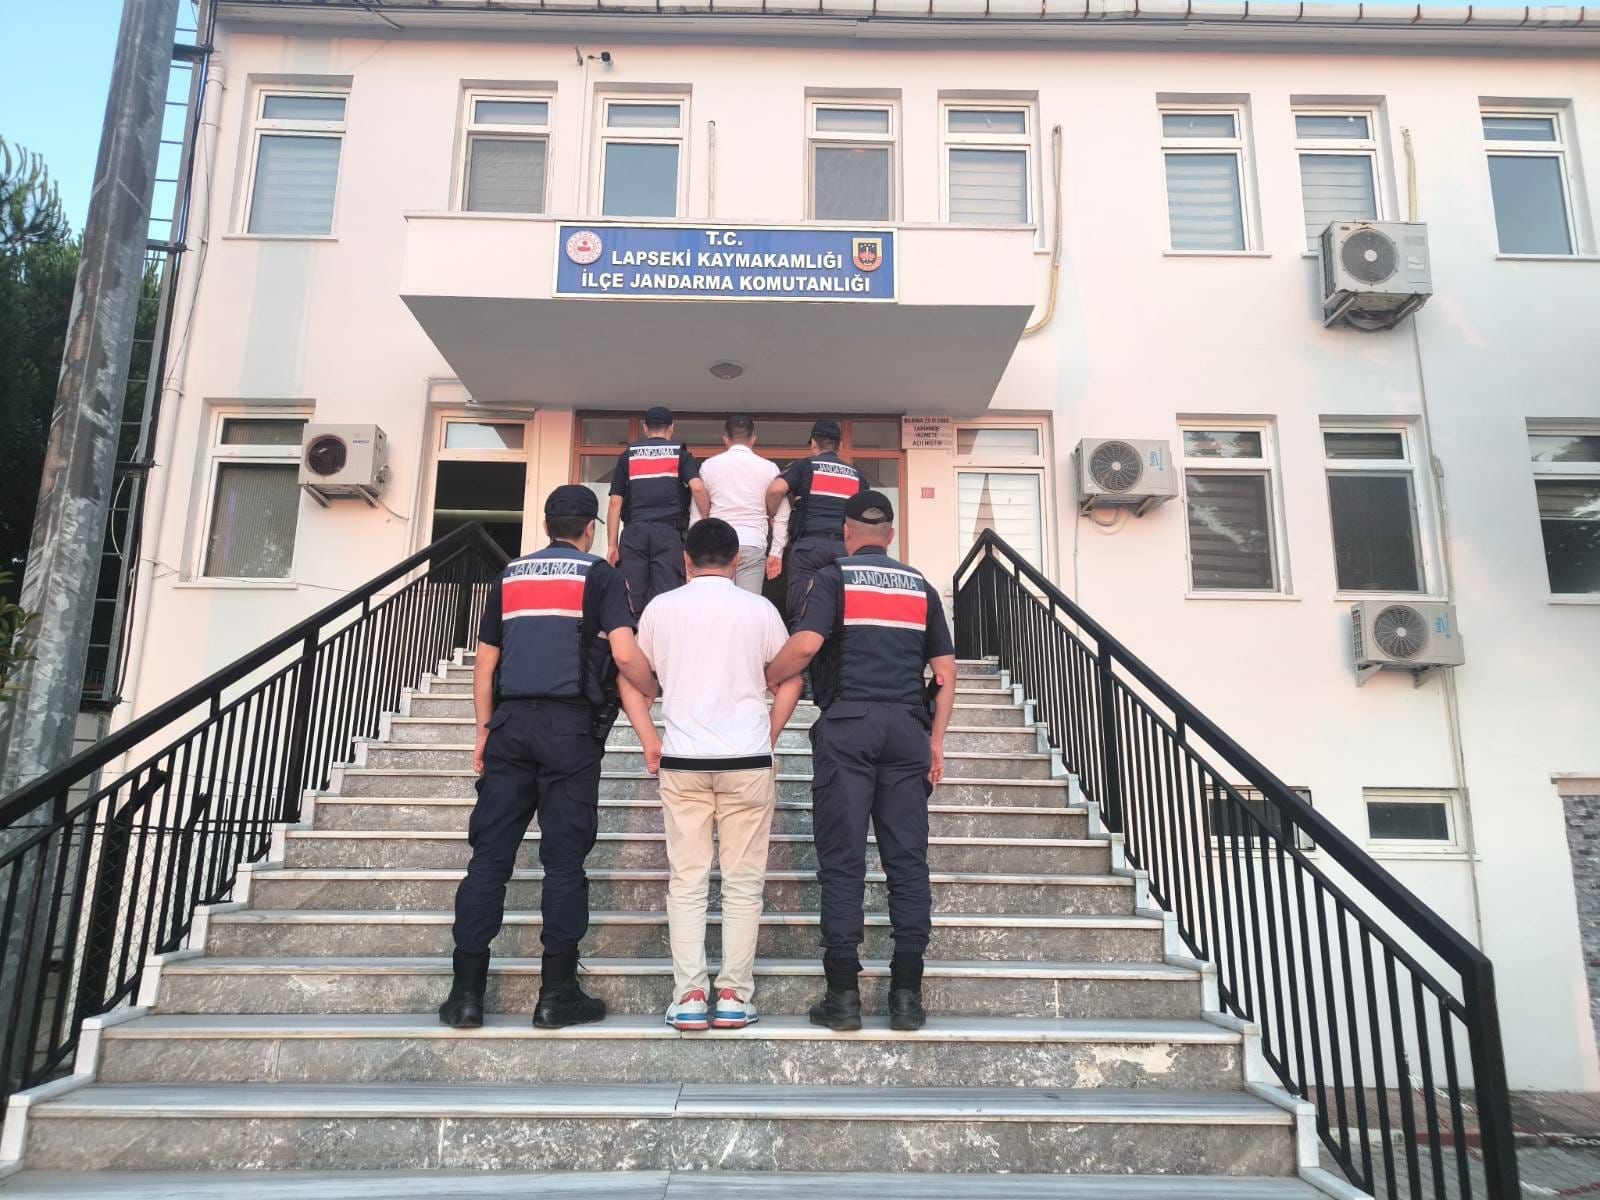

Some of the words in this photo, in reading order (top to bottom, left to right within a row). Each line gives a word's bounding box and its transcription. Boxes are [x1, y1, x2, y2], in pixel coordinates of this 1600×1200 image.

[706, 231, 743, 246] T.C.
[611, 249, 691, 267] LAPSEKİ
[697, 251, 842, 269] KAYMAKAMLIĞI
[581, 268, 624, 292] İLÇE
[630, 273, 734, 291] JANDARMA
[739, 273, 871, 292] KOMUTANLIĞI
[634, 448, 674, 457] JANDARMA
[818, 463, 855, 477] JANDARMA
[510, 561, 578, 577] JANDARMA
[852, 570, 919, 591] JANDARMA
